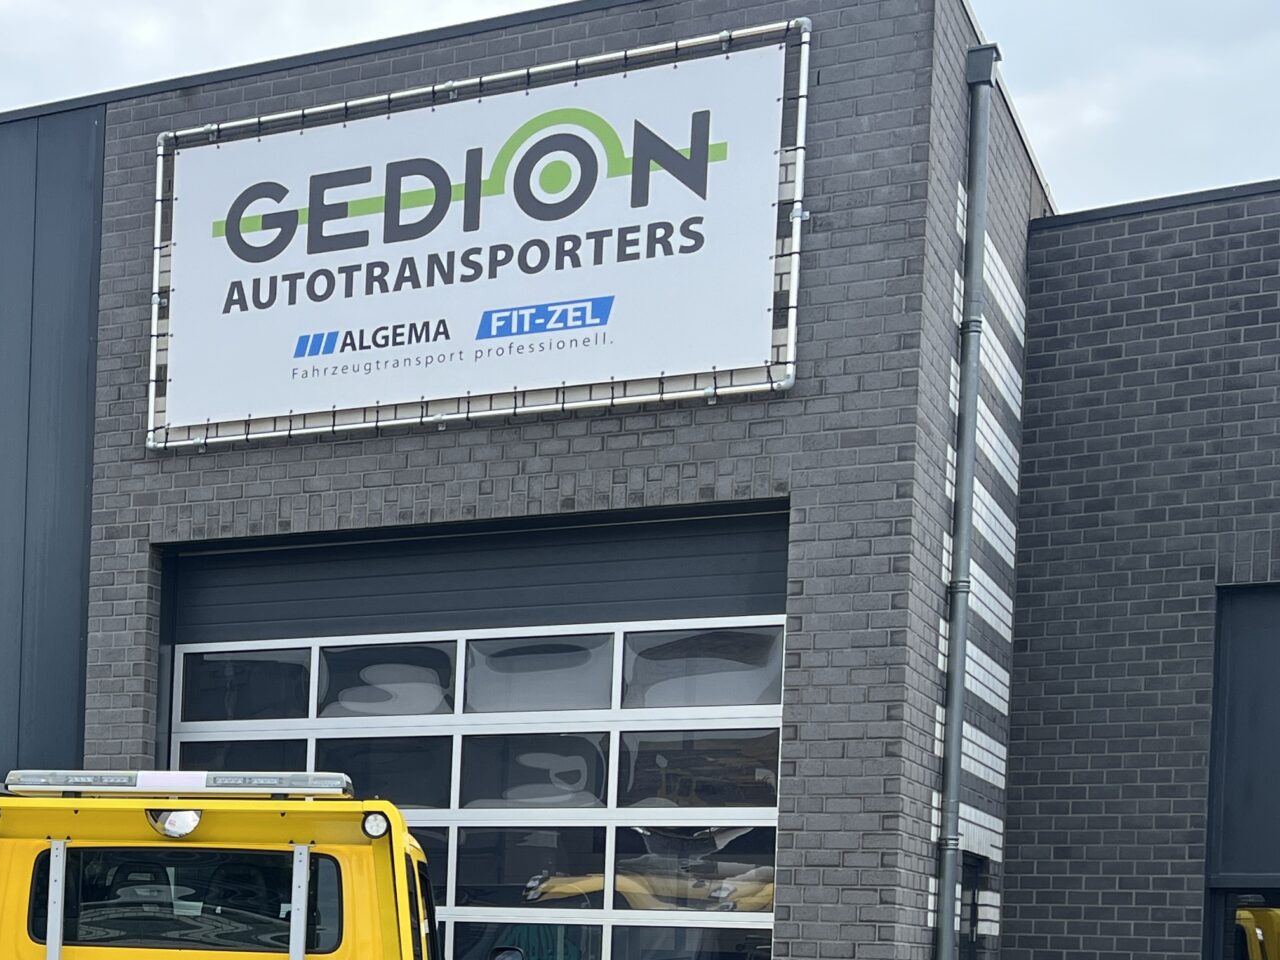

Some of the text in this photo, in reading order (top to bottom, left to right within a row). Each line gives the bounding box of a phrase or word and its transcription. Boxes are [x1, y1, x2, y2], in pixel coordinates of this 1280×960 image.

[225, 109, 710, 263] GEDION
[222, 216, 705, 314] AUTOTRANSPORTERS
[291, 332, 615, 380] Fahrzeugtransport professionell.
[339, 301, 600, 353] ALGEMA FIT-ZEL
